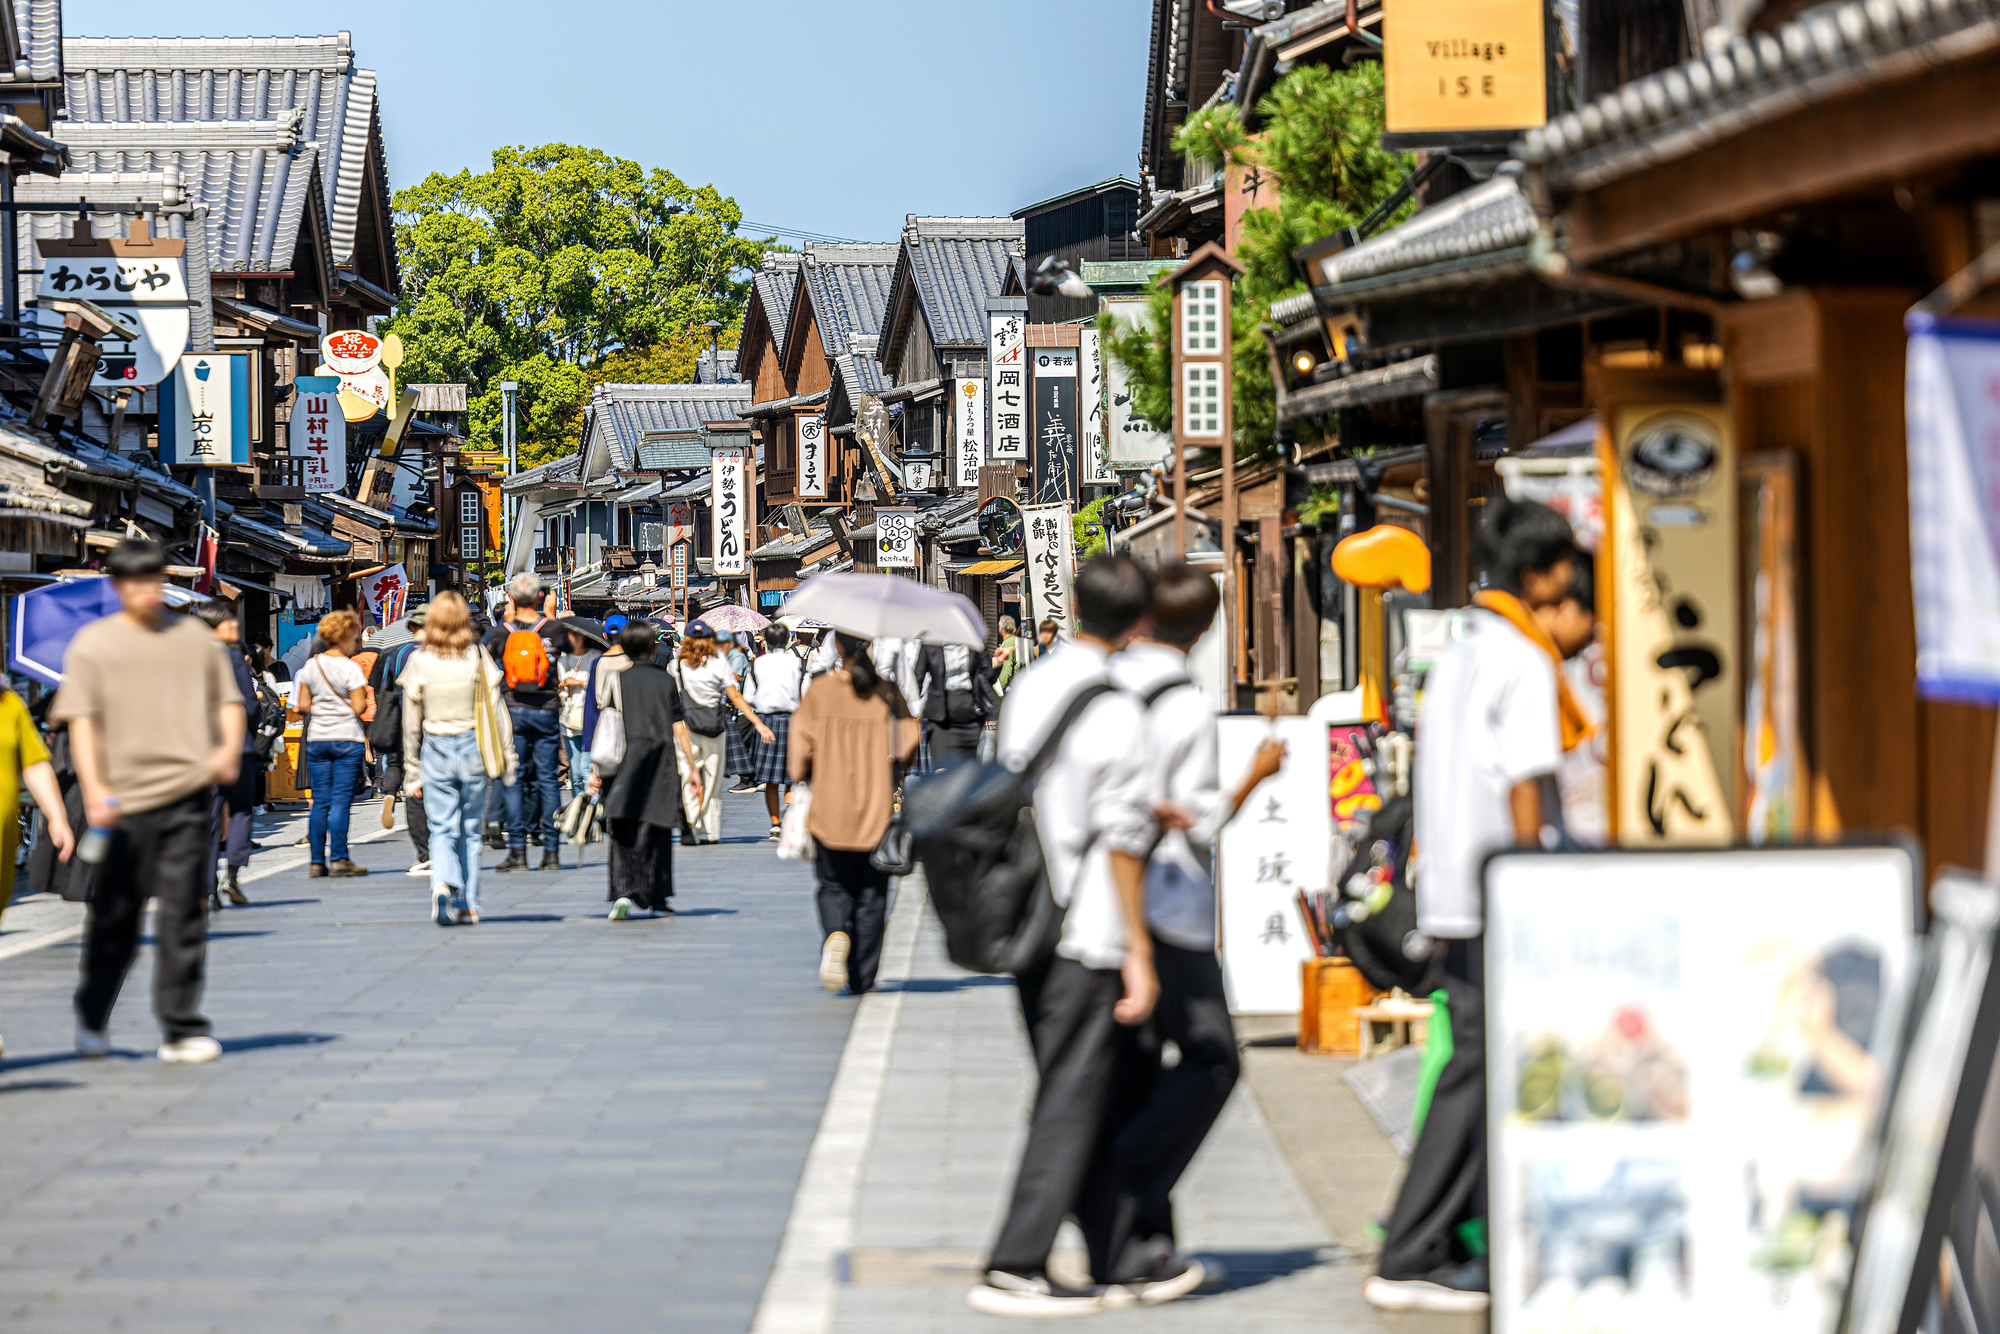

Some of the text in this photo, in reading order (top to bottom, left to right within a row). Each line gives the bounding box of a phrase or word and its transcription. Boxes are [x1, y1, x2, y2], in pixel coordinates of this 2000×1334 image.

[1426, 40, 1506, 62] Village
[1438, 75, 1494, 97] ISE
[50, 264, 171, 292] わらじや
[1052, 355, 1073, 367] 若戎
[966, 400, 975, 437] はちみつ屋
[996, 370, 1021, 452] 岡七酒店
[189, 409, 216, 457] 岩座
[307, 397, 329, 475] 山村牛乳
[804, 443, 821, 491] まる天
[962, 438, 979, 483] 松治郎
[720, 465, 739, 558] 伊勢うどん
[718, 560, 741, 569] 中井屋
